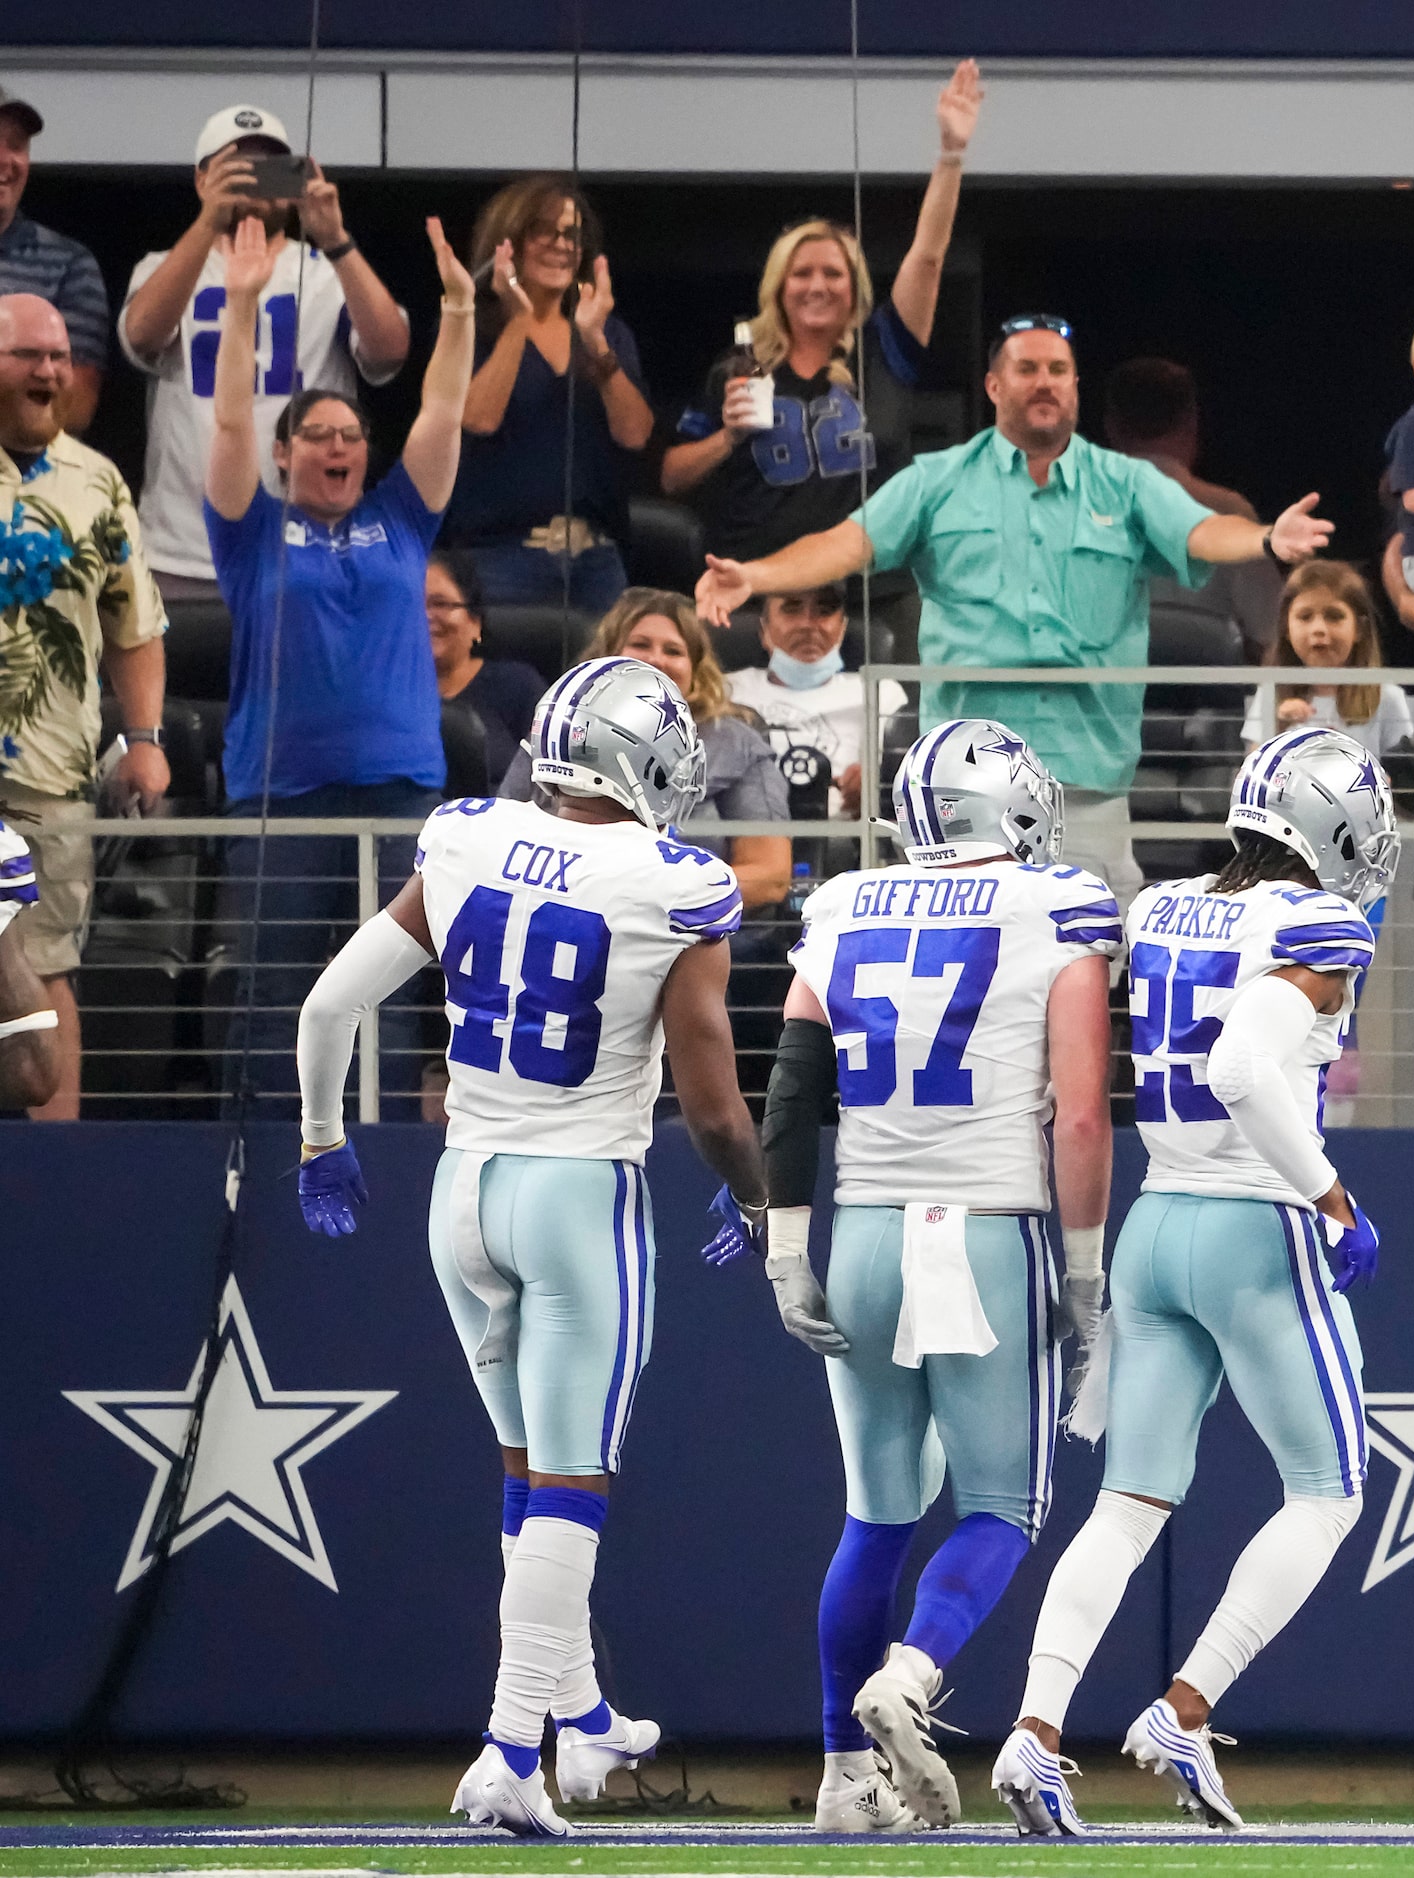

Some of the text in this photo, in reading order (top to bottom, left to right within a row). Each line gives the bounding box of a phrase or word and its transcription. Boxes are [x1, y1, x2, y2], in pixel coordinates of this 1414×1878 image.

[537, 763, 574, 777] COWBOYS
[502, 840, 582, 893] COX
[911, 849, 957, 861] COWBOYS
[852, 878, 999, 919] GIFFORD
[1140, 895, 1246, 940] PARKER
[440, 884, 612, 1088] 48
[826, 927, 1000, 1107] 57
[1130, 942, 1241, 1123] 25
[854, 1802, 881, 1817] adidas
